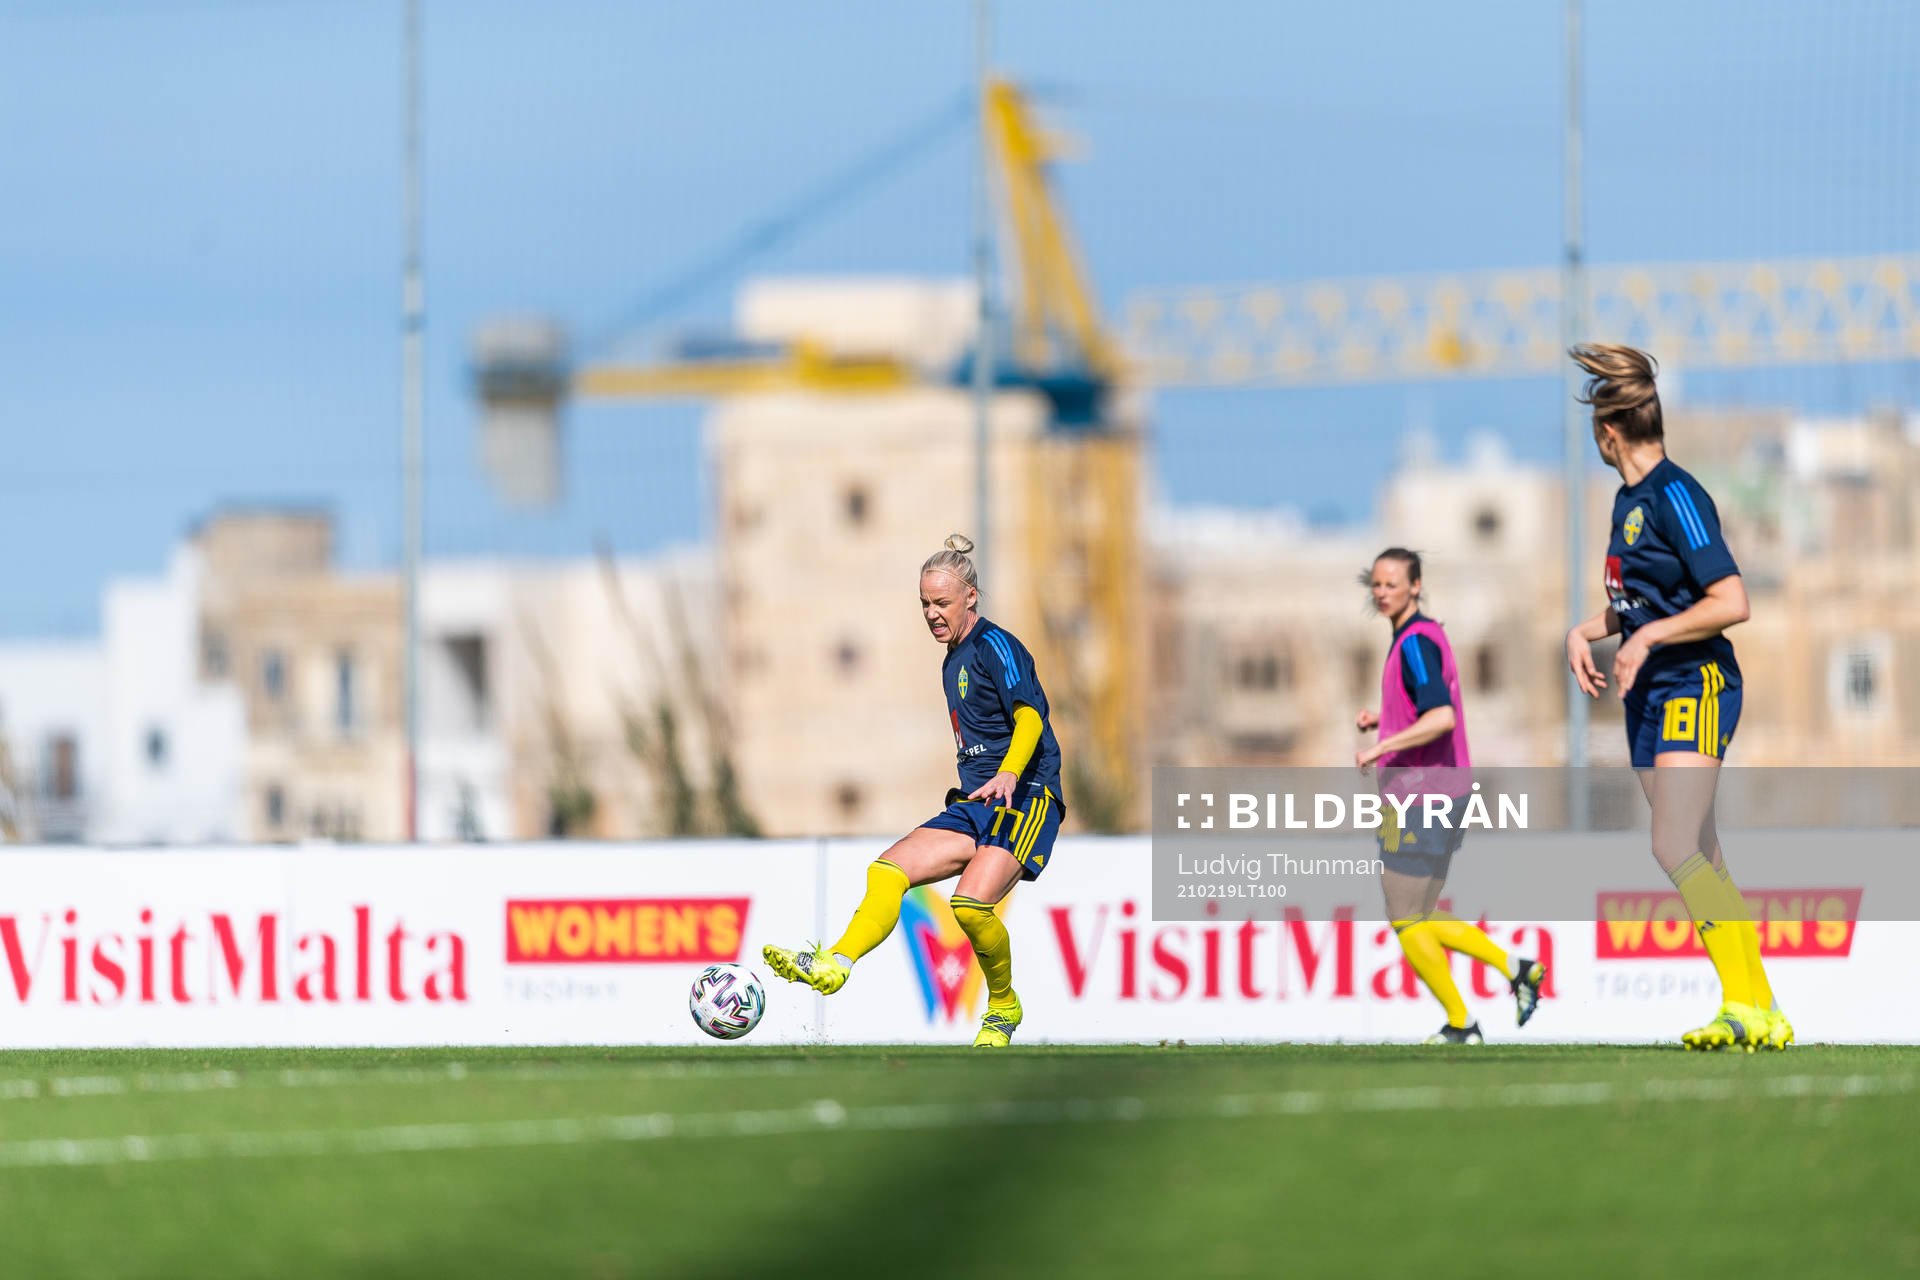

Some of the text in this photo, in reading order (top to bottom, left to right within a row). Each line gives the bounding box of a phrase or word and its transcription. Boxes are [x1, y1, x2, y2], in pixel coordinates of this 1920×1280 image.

[1662, 697, 1697, 741] 18
[510, 904, 740, 958] WOMEN'S
[1602, 896, 1849, 952] WON'S
[0, 904, 470, 1004] VisitMalta
